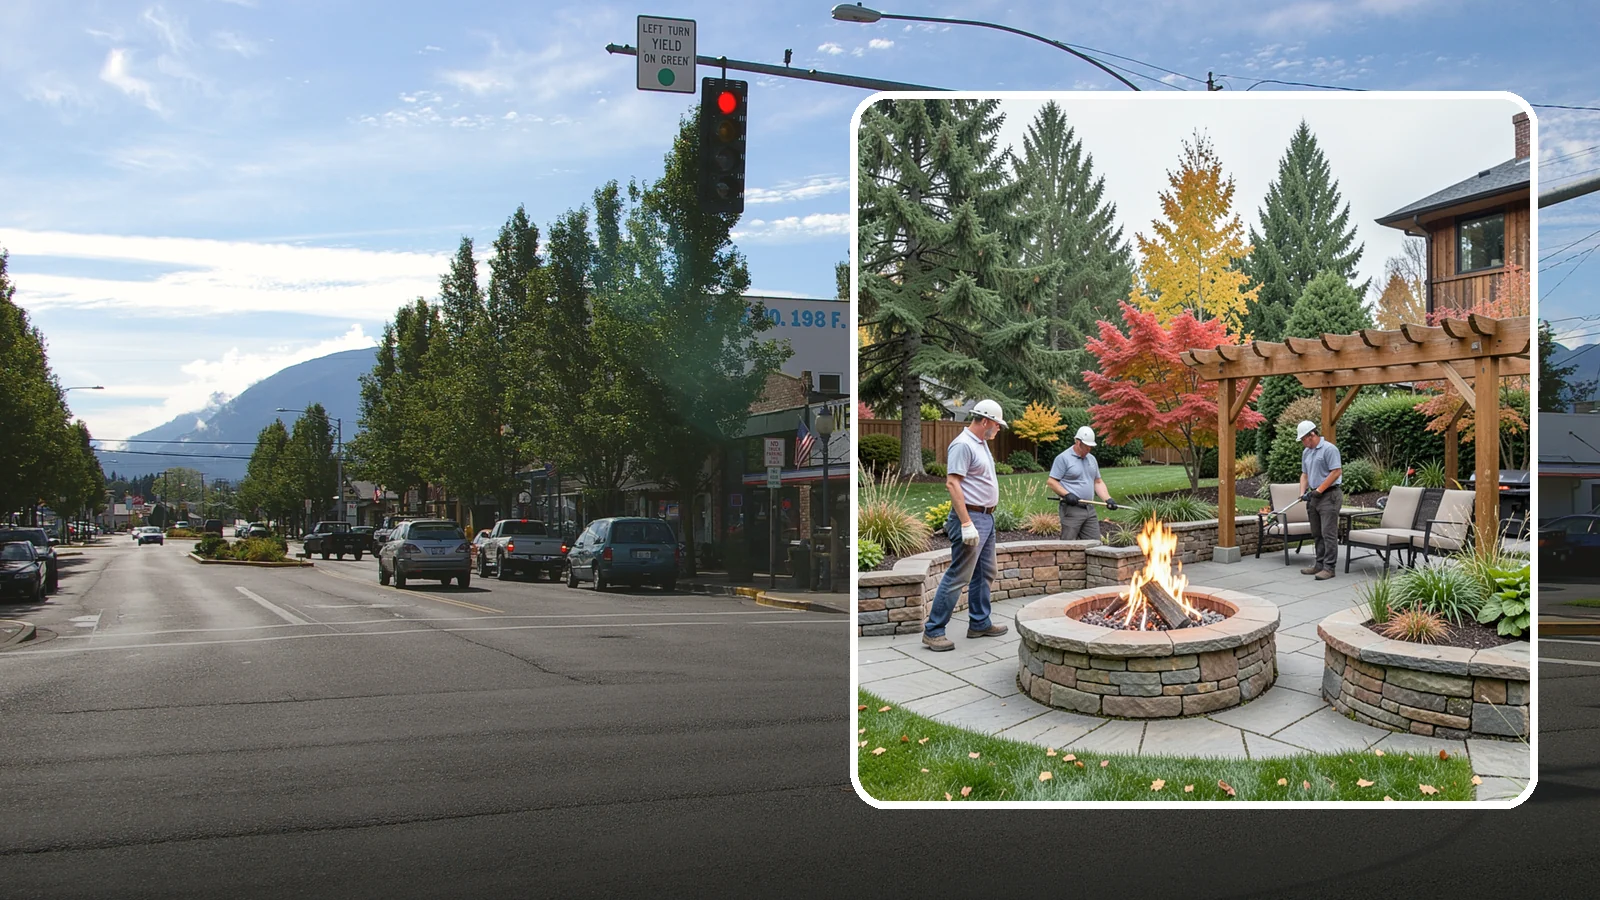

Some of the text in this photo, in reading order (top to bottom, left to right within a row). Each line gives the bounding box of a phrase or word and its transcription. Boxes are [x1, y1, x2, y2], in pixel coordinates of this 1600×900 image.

[643, 23, 690, 36] LEFT TURN
[652, 38, 682, 52] YIELD
[644, 53, 689, 66] ON GREEN
[791, 309, 826, 328] 198
[831, 311, 846, 329] F.
